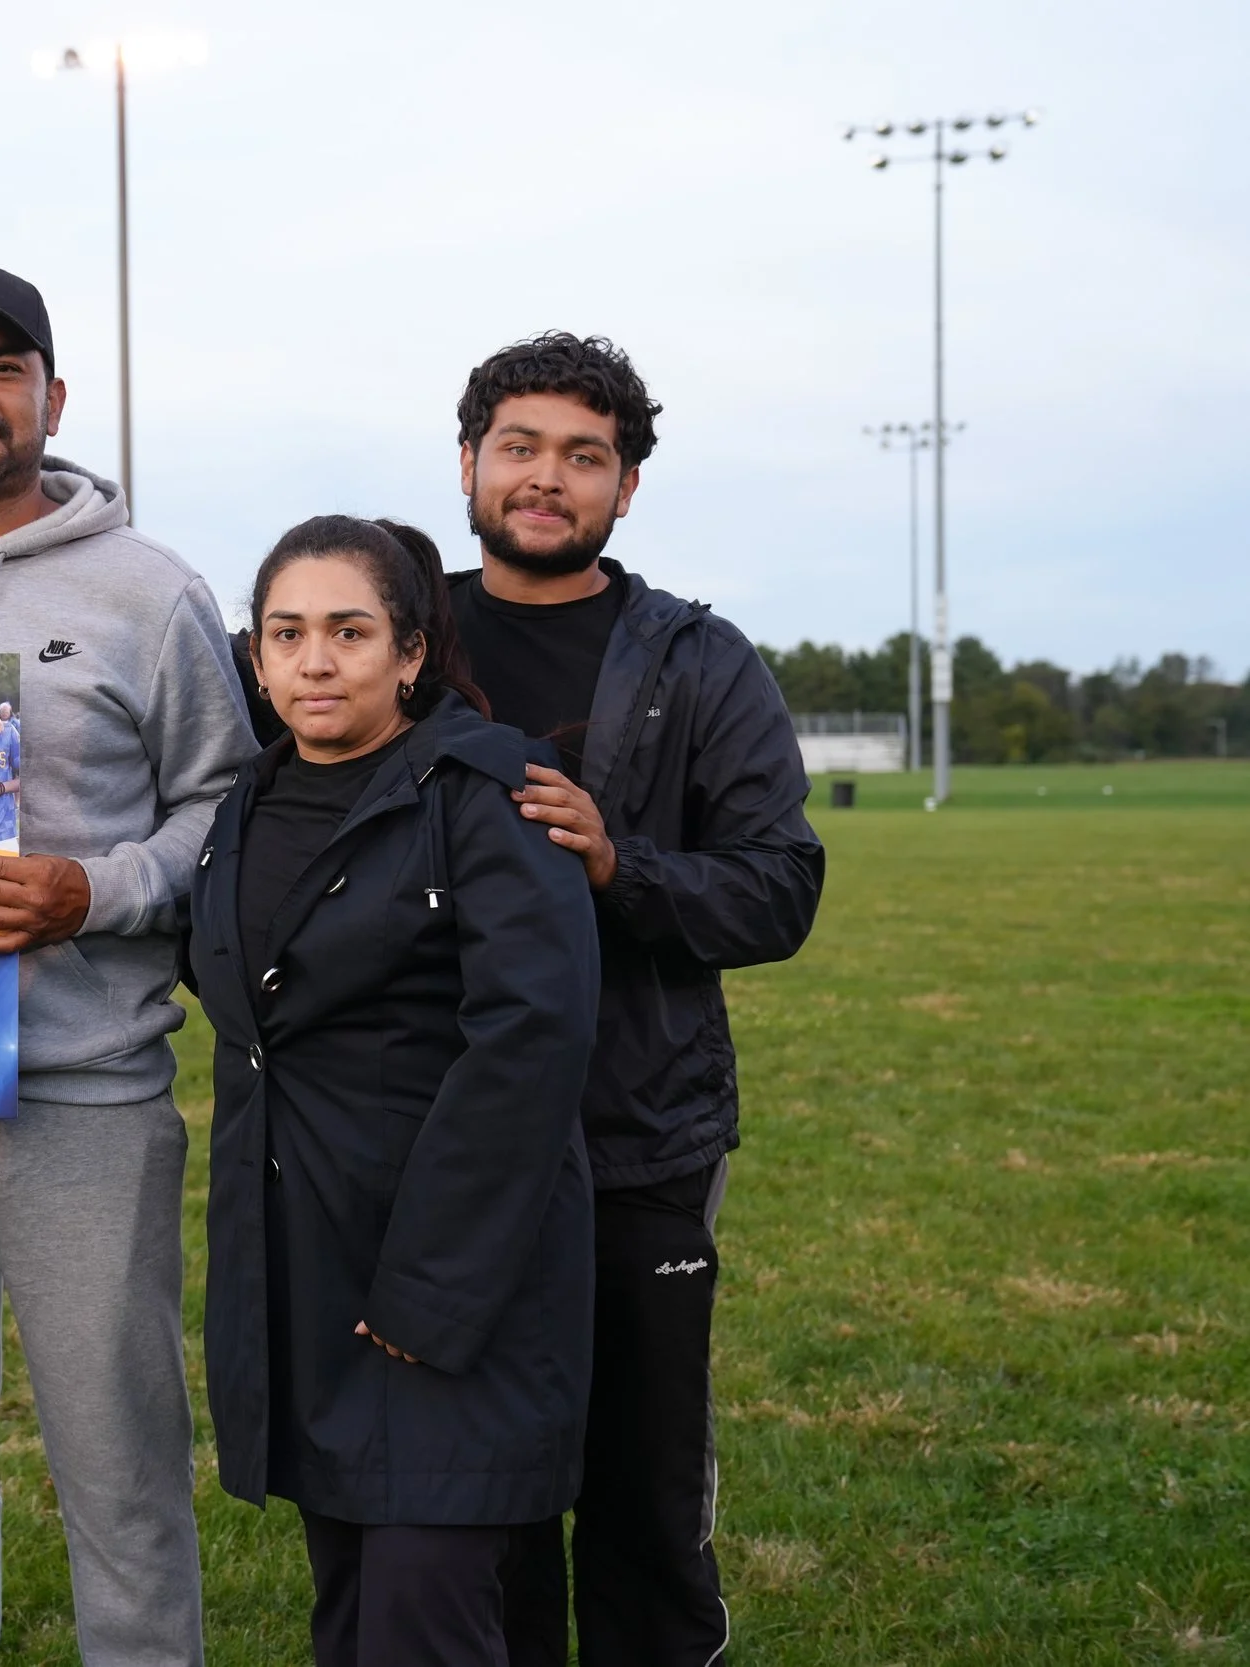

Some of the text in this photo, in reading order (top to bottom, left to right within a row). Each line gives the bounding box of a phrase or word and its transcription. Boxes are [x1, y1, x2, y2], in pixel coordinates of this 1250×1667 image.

[46, 639, 76, 655] NIKE
[655, 1257, 708, 1275] Los Angeles
